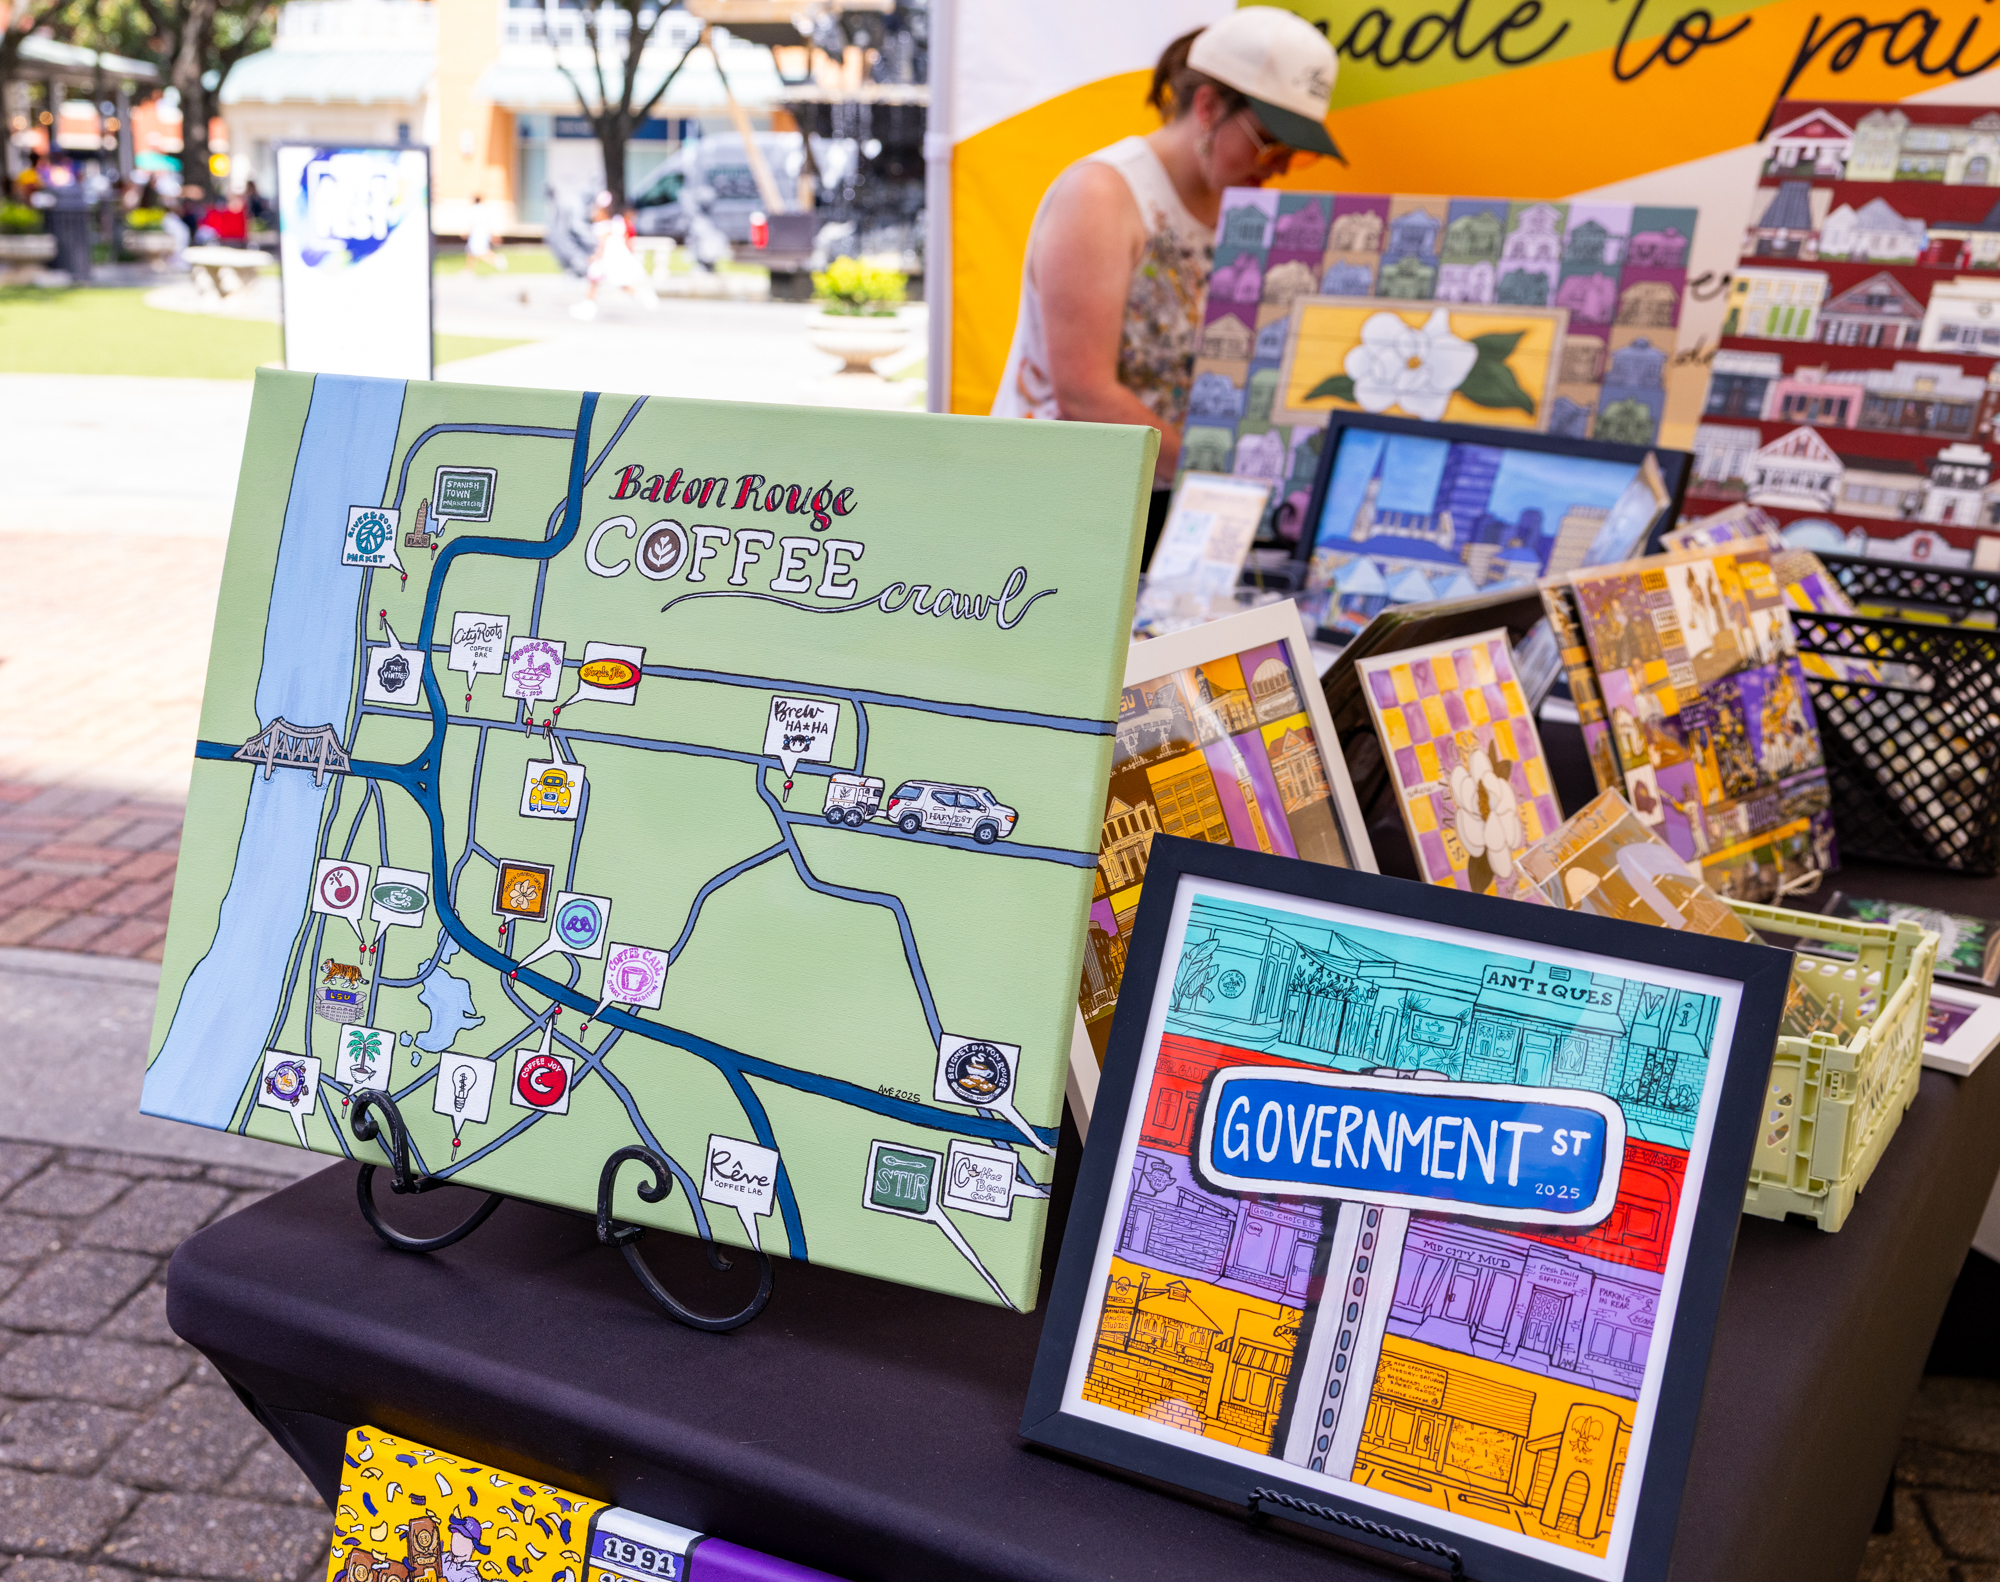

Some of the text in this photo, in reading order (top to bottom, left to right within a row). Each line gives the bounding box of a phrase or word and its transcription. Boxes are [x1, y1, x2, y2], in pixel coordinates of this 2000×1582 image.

[1313, 0, 1570, 68] ade
[446, 489, 471, 498] TOWN
[447, 480, 480, 491] SPANISH
[609, 464, 858, 532] Baton Rouge
[346, 553, 385, 563] MARKET
[584, 515, 1058, 630] COFFEE crawl
[454, 628, 477, 647] City
[774, 700, 824, 722] Brew
[929, 812, 972, 823] HARVEST
[609, 948, 664, 976] COFFEE CALL
[330, 992, 351, 1001] LSU
[607, 980, 621, 998] START
[1486, 971, 1613, 1006] ANTIQUES
[521, 1058, 561, 1078] COFFEE JOY
[947, 1045, 1008, 1088] BEIGNET BATON ROUGE
[896, 1090, 921, 1103] 2025
[1223, 1096, 1591, 1187] GOVERNMENT ST
[709, 1148, 771, 1187] Rêve
[714, 1180, 763, 1196] COFFEE LAB
[876, 1168, 929, 1202] STIR
[976, 1178, 1006, 1195] Bean
[1535, 1183, 1580, 1199] 2025
[970, 1192, 996, 1203] Cafe
[1254, 1207, 1316, 1228] GOOD CHOICES
[1423, 1240, 1510, 1268] MID CITY MUD
[1540, 1264, 1580, 1281] Fresh Daily
[1563, 1280, 1577, 1288] HOT
[1599, 1288, 1632, 1303] PARKING
[1611, 1301, 1630, 1310] REAR
[1103, 1322, 1129, 1330] STUDIOS
[1407, 1364, 1423, 1372] OPEN
[605, 1539, 672, 1576] 1991
